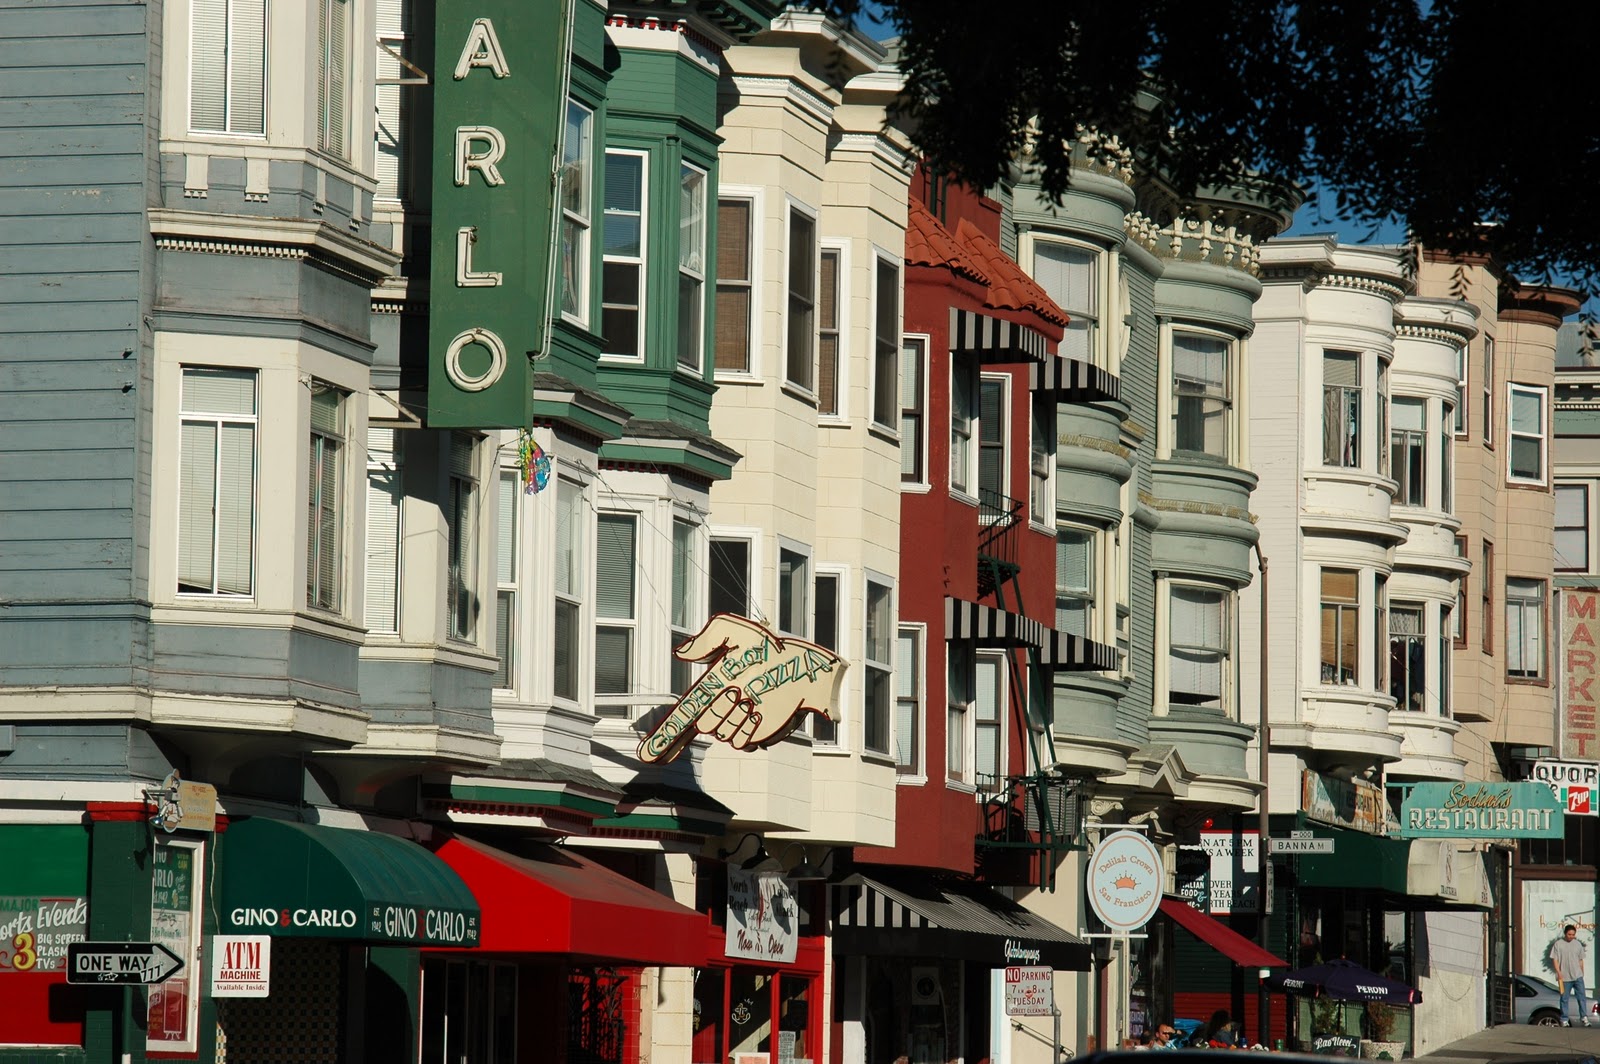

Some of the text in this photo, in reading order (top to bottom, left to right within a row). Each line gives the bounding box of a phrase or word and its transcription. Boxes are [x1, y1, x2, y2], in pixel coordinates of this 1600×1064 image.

[445, 17, 511, 393] ARLO
[744, 648, 834, 705] PIZZA
[1567, 594, 1597, 757] MARKET
[649, 671, 725, 757] GOLDEN
[1409, 807, 1555, 831] RESTAURANT
[1212, 838, 1226, 847] AT
[1236, 838, 1253, 847] PM
[1278, 841, 1325, 851] BANNAM
[1216, 848, 1223, 857] A
[1225, 848, 1254, 857] WEEK
[1098, 854, 1127, 874] Delilah
[1129, 855, 1154, 876] Crown
[1098, 886, 1112, 902] San
[1113, 889, 1152, 908] Francisco
[1180, 888, 1198, 897] FOOD
[1213, 890, 1243, 899] YEARS
[0, 897, 39, 912] MAJOR
[1226, 900, 1256, 908] BEACH
[36, 897, 87, 929] Events
[231, 908, 357, 927] GINO & CARLO
[371, 921, 382, 933] 1942
[384, 906, 465, 942] GINO & CARLO
[37, 933, 87, 945] BIG SCREEN
[12, 932, 37, 971] 3
[221, 941, 261, 970] ATM
[79, 955, 151, 971] ONE WAY
[141, 964, 161, 982] 777
[220, 970, 261, 980] MACHINE
[1007, 968, 1051, 982] NO PARKING
[1011, 984, 1017, 994] 7
[1032, 984, 1038, 994] 8
[1283, 978, 1305, 989] PERONI
[1356, 984, 1389, 995] PERONI
[1013, 997, 1046, 1005] TUESDAY
